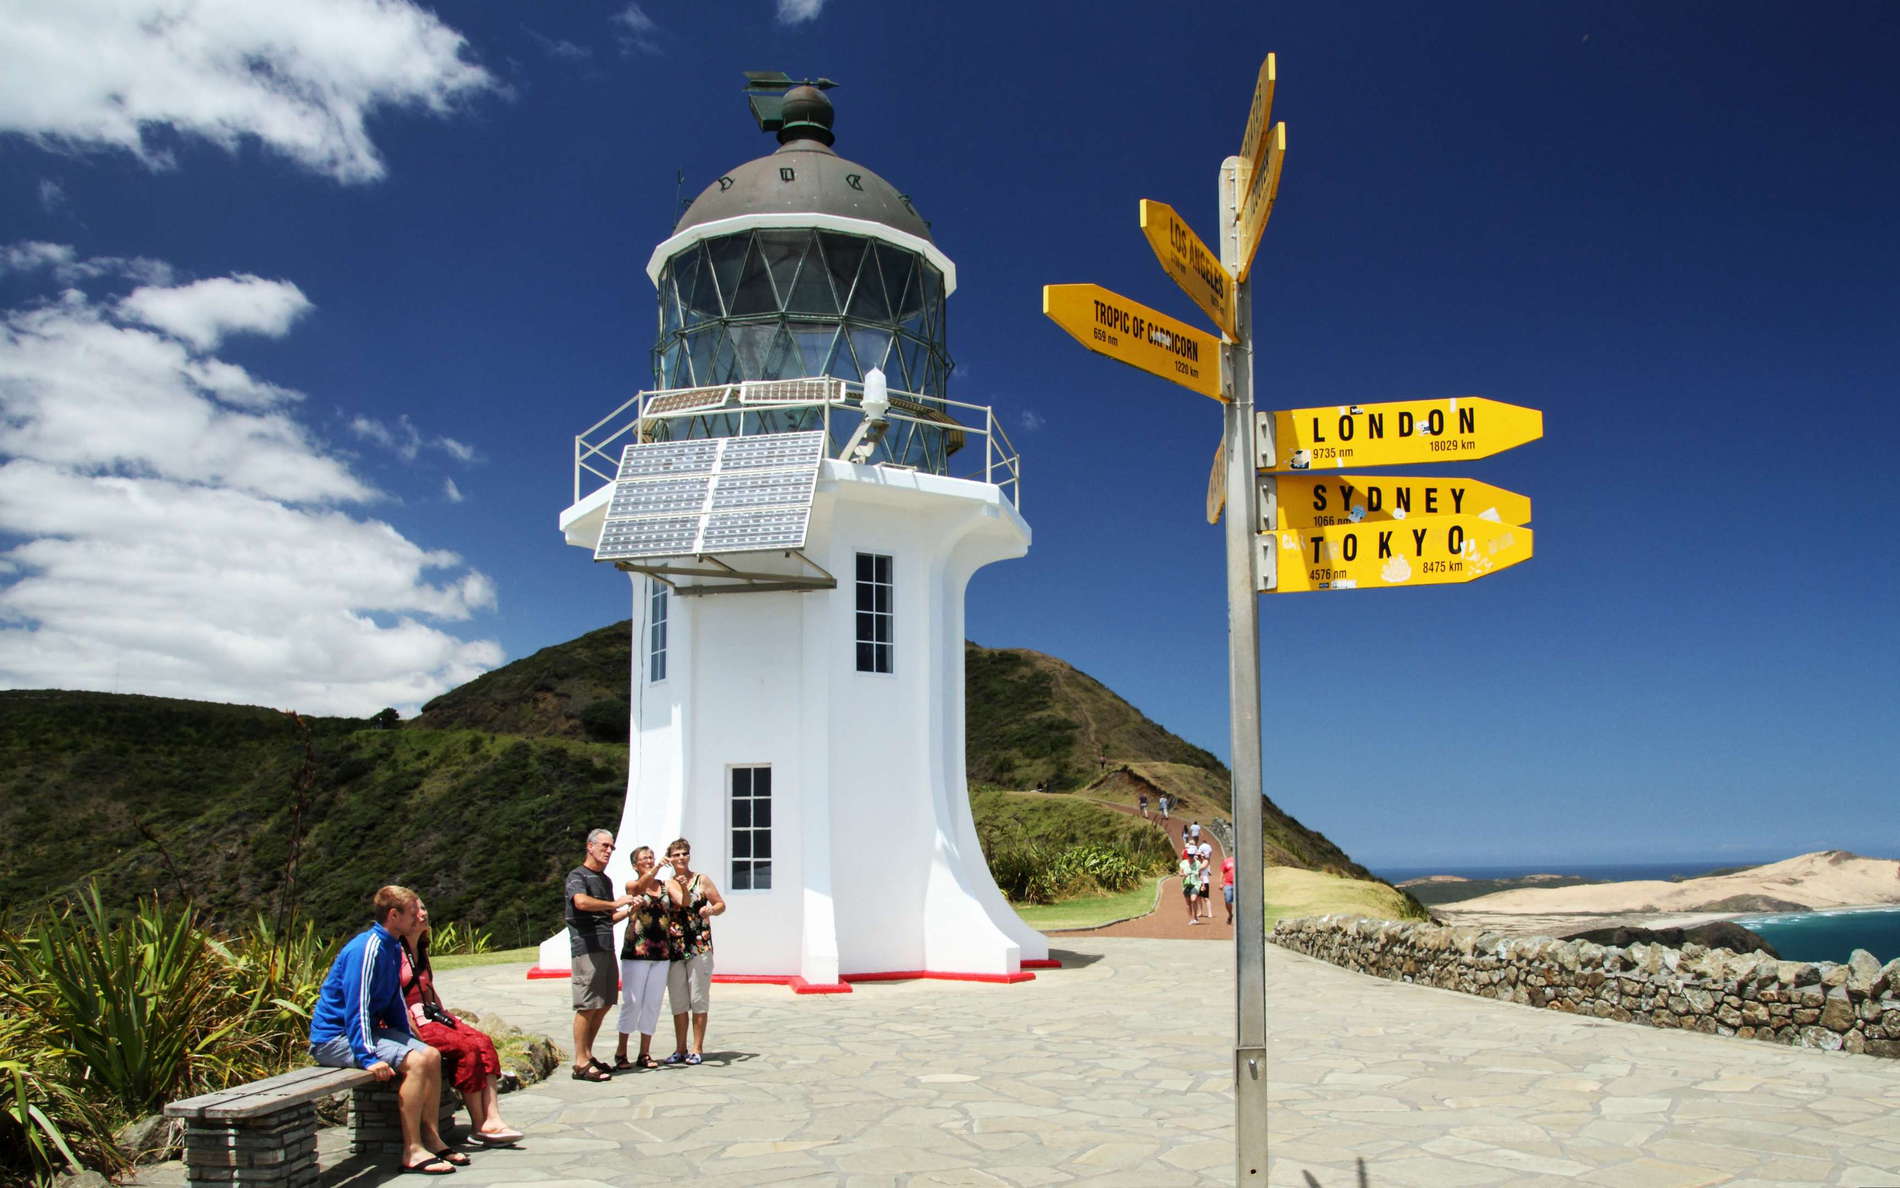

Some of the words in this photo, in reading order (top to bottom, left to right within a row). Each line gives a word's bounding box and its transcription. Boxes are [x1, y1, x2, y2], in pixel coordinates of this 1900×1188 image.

[1170, 216, 1186, 259] LOS
[1190, 239, 1223, 299] ANGELES
[1094, 299, 1130, 334] TROPIC
[1133, 316, 1144, 339] OF
[1094, 327, 1106, 342] 659
[1108, 335, 1118, 346] nm
[1175, 360, 1189, 375] 1220
[1190, 367, 1199, 378] km
[1313, 407, 1475, 443] LONDON
[1313, 448, 1336, 459] 9735
[1339, 448, 1353, 458] nm
[1430, 440, 1458, 452] 18029
[1461, 439, 1475, 450] km
[1313, 484, 1465, 514] SYDNEY
[1313, 515, 1335, 528] 1066
[1310, 525, 1464, 564] TOKYO
[1309, 568, 1331, 581] 4576
[1333, 569, 1347, 579] nm
[1423, 561, 1446, 574] 8475
[1449, 560, 1463, 572] km
